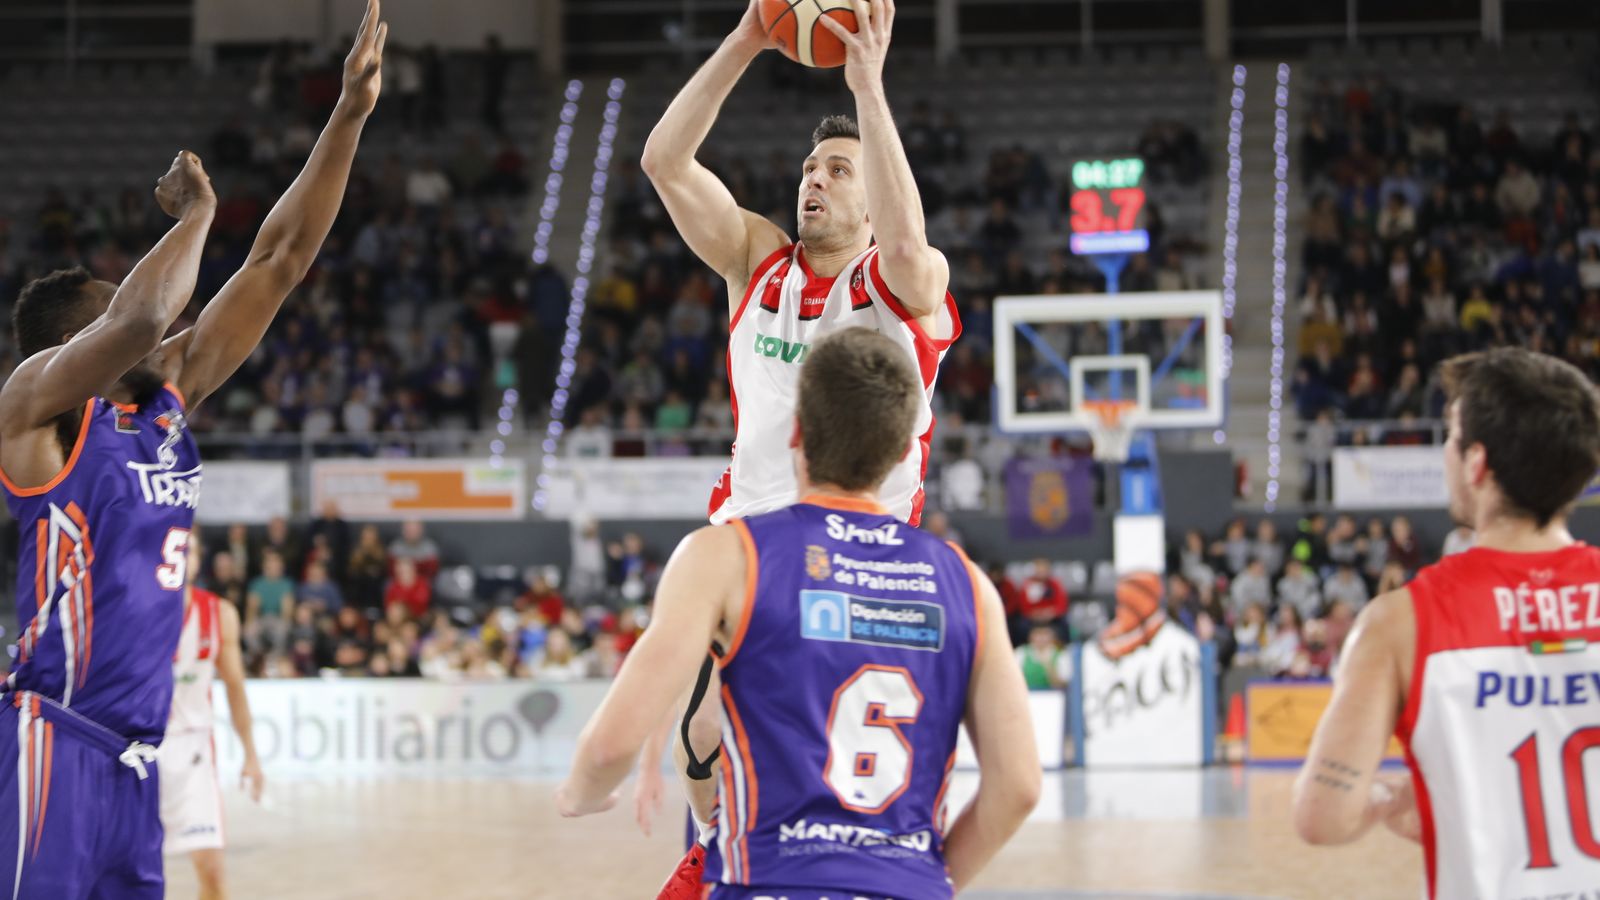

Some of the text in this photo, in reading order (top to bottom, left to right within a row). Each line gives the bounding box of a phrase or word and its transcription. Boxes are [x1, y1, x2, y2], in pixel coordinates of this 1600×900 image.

[1070, 188, 1146, 235] 3.7
[832, 553, 935, 576] Ayuntamiento
[833, 570, 937, 594] de Palencia
[851, 603, 926, 624] Diputación
[1492, 582, 1600, 632] PÉREZ
[852, 621, 873, 635] DE
[822, 663, 925, 815] 6
[1508, 726, 1600, 870] 10
